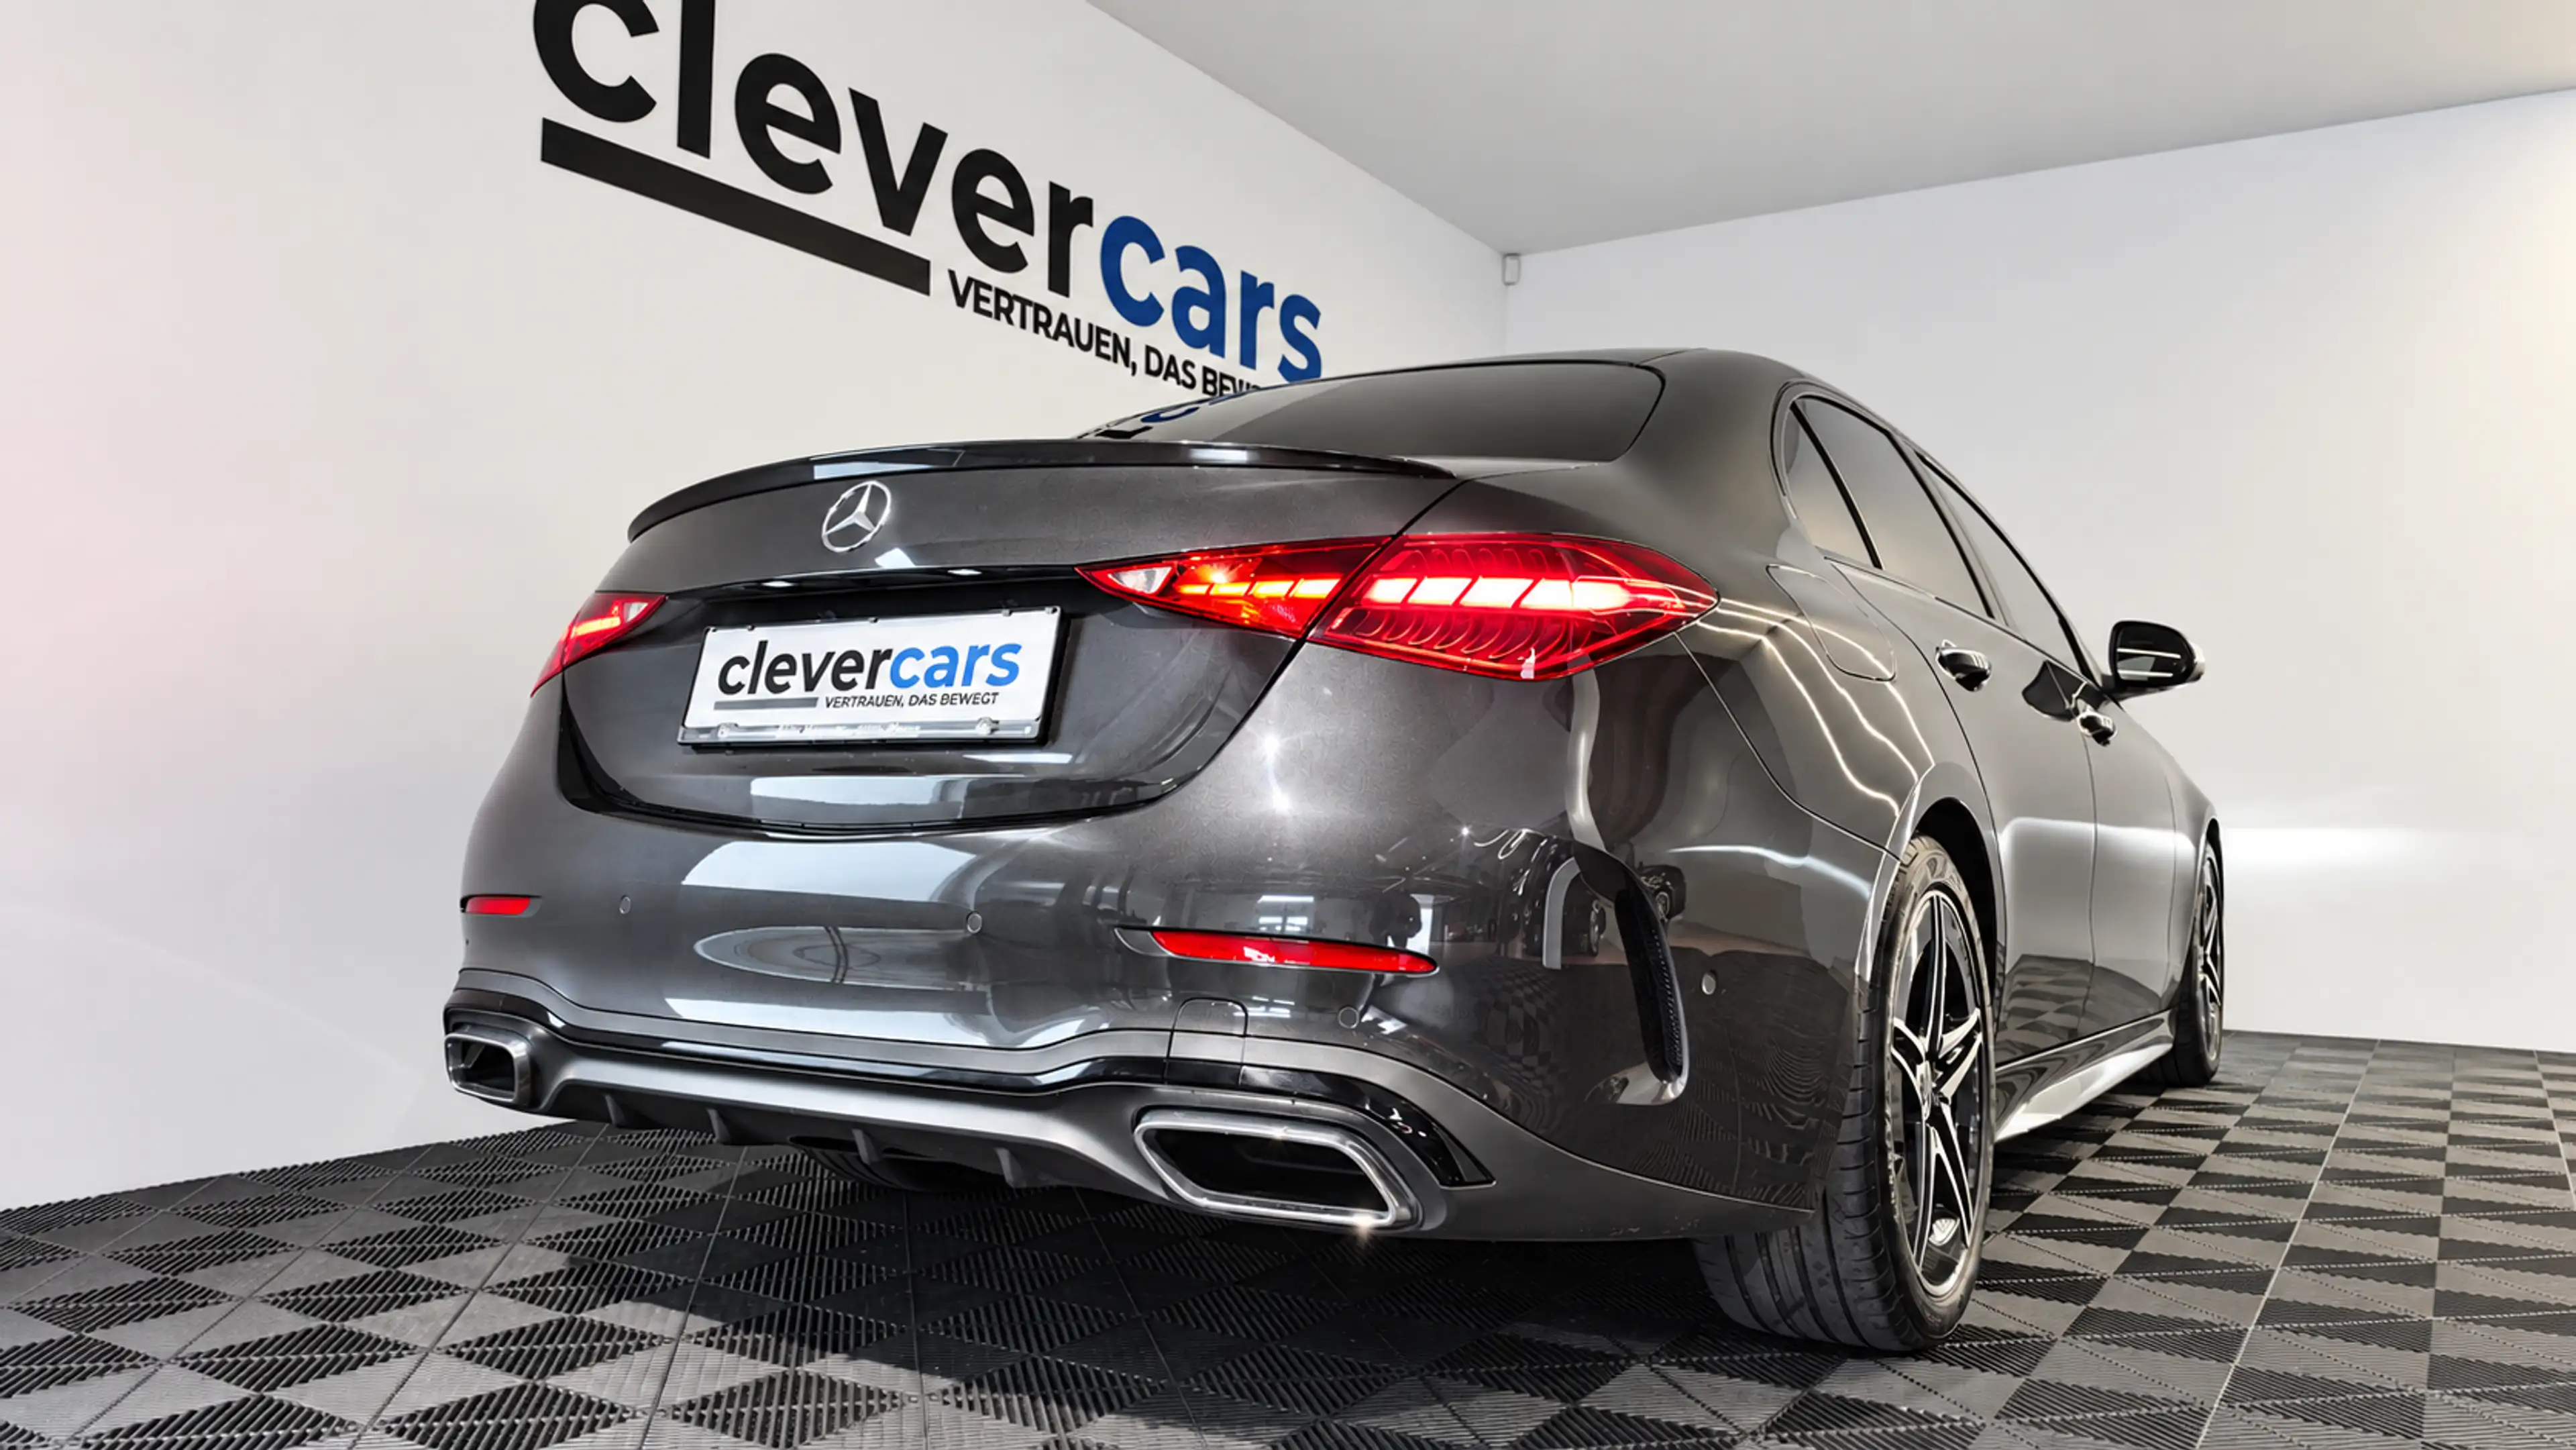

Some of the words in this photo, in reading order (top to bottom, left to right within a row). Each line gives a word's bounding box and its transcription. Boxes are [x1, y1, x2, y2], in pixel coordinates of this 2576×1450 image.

[947, 268, 1137, 376] VERTRAUEN,
[1145, 344, 1197, 390] DAS
[718, 640, 1022, 695] clevercars
[825, 695, 904, 709] VERTRAUEN,
[908, 694, 937, 707] DAS
[940, 692, 999, 706] BEWEGT
